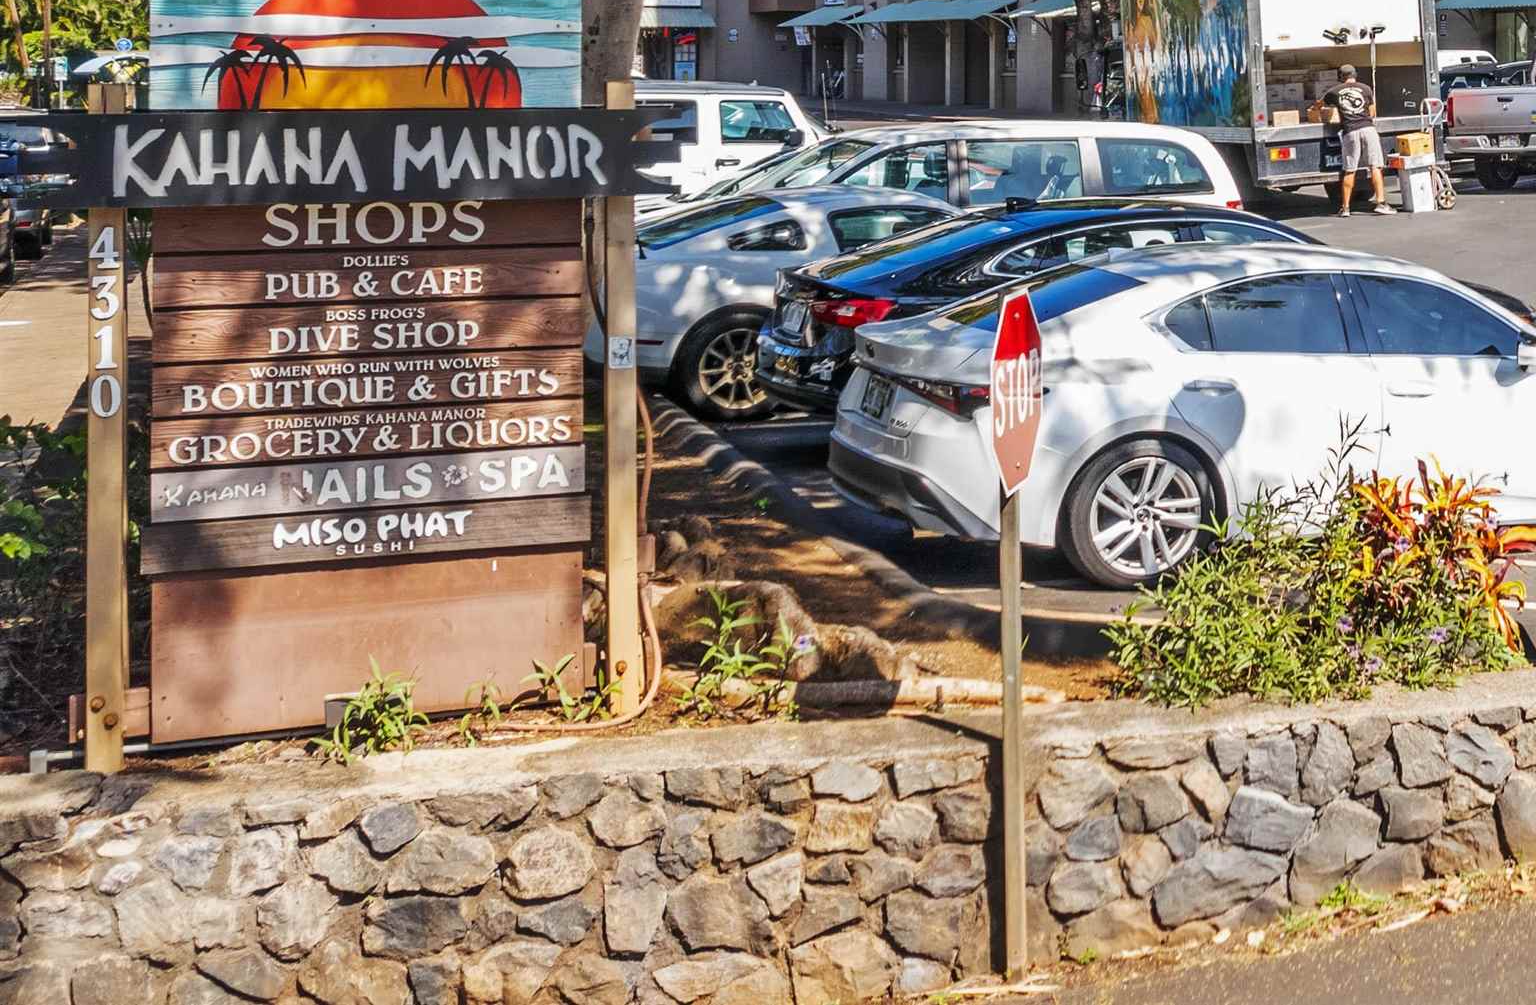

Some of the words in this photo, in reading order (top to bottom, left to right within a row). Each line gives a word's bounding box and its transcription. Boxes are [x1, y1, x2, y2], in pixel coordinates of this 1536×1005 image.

[113, 123, 368, 197] KAHANA
[393, 123, 608, 191] MANOR
[261, 200, 485, 247] SHOPS
[343, 254, 409, 268] DOLLIE'S
[265, 271, 341, 300] PUB
[352, 271, 380, 297] &
[391, 267, 484, 296] CAFE
[325, 309, 366, 321] BOSS
[370, 307, 426, 320] FROG'S
[268, 325, 360, 354] DIVE
[371, 320, 480, 350] SHOP
[249, 365, 312, 379] WOMEN
[315, 362, 356, 376] WHO
[359, 361, 389, 374] RUN
[394, 359, 434, 372] WITH
[437, 356, 500, 370] WOLVES
[181, 376, 396, 413] BOUTIQUE
[407, 374, 437, 401] &
[450, 369, 561, 398] GIFTS
[996, 349, 1042, 437] STOP
[264, 414, 360, 429] TRADEWINDS
[364, 411, 428, 424] KAHANA
[431, 408, 486, 421] MANOR
[168, 425, 368, 464] GROCERY
[372, 425, 401, 451] &
[410, 415, 571, 450] LIQUORS
[161, 482, 267, 508] KAHANA
[479, 454, 570, 492] SPA
[272, 518, 367, 550] MISO
[377, 510, 474, 541] PHAT
[336, 541, 414, 556] SUSHI
